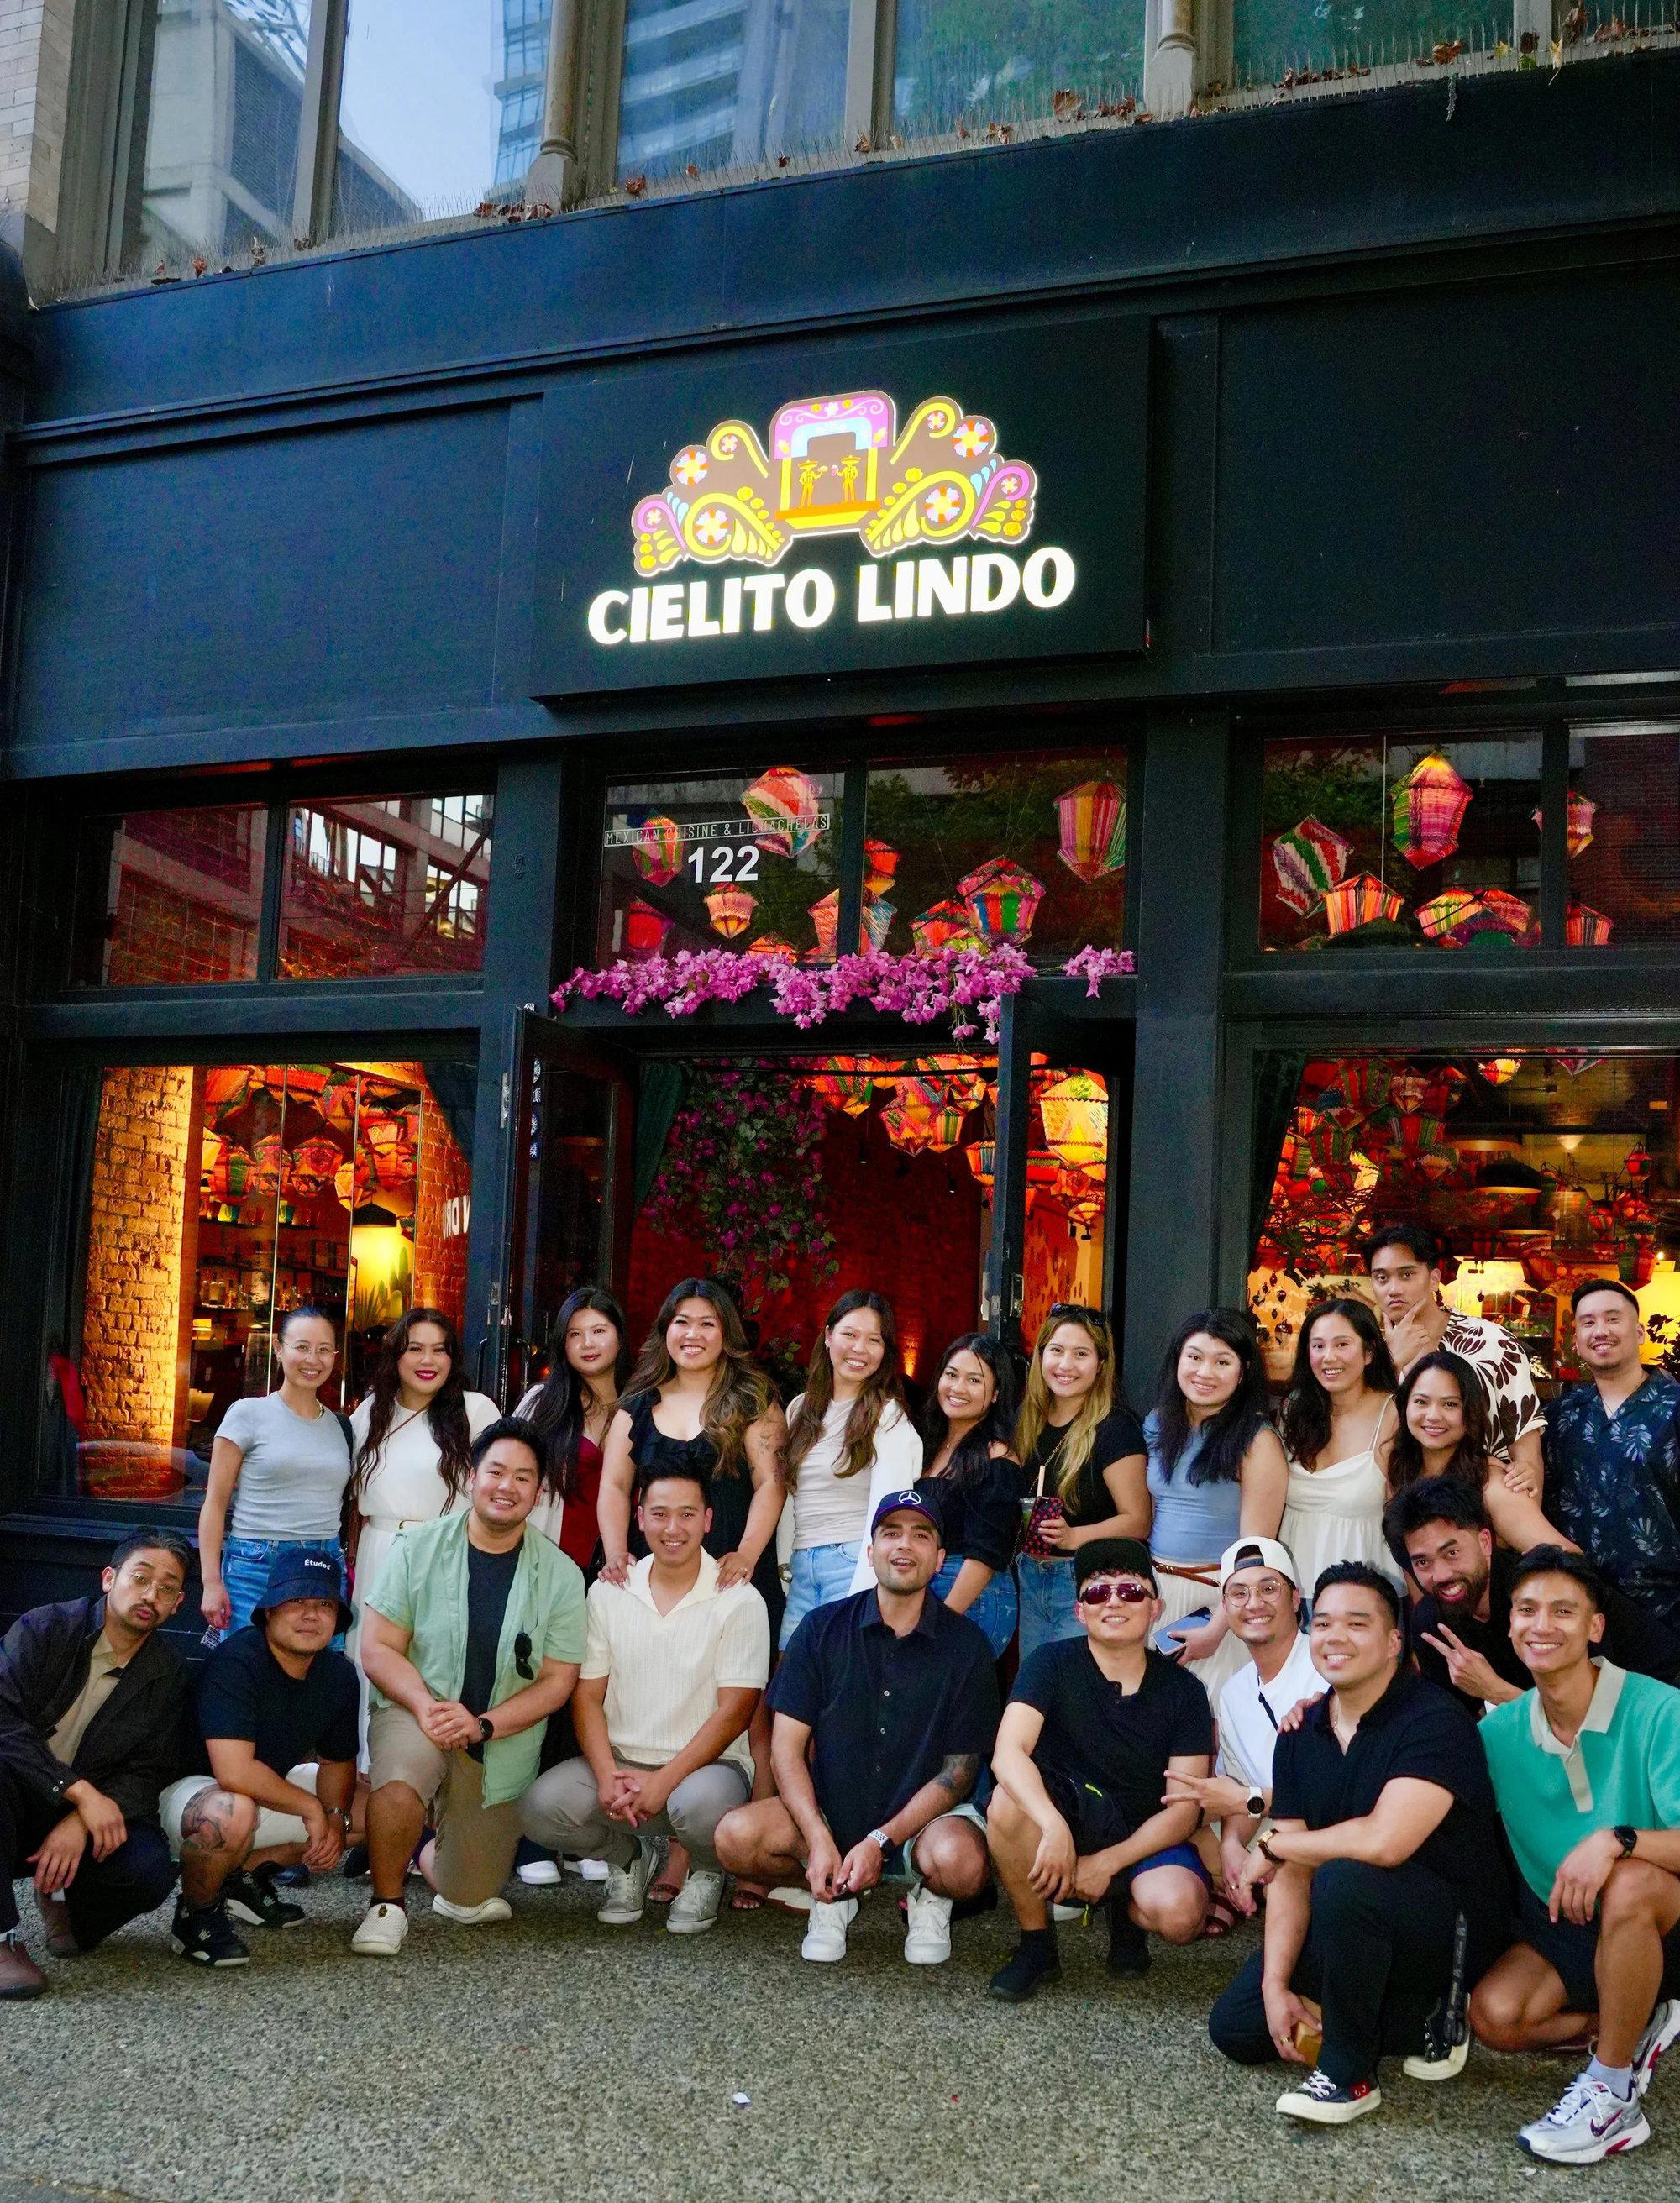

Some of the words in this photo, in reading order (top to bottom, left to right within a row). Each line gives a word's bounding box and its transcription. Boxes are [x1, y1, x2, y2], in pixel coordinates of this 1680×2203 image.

[587, 568, 835, 645] CIELITO
[858, 547, 1075, 622] LINDO
[606, 829, 659, 845] MEXICAN
[666, 824, 717, 840] CUISINE
[723, 823, 732, 836] &
[739, 816, 827, 834] LICUACHELAS
[688, 845, 759, 884] 122
[304, 1558, 332, 1570] Études
